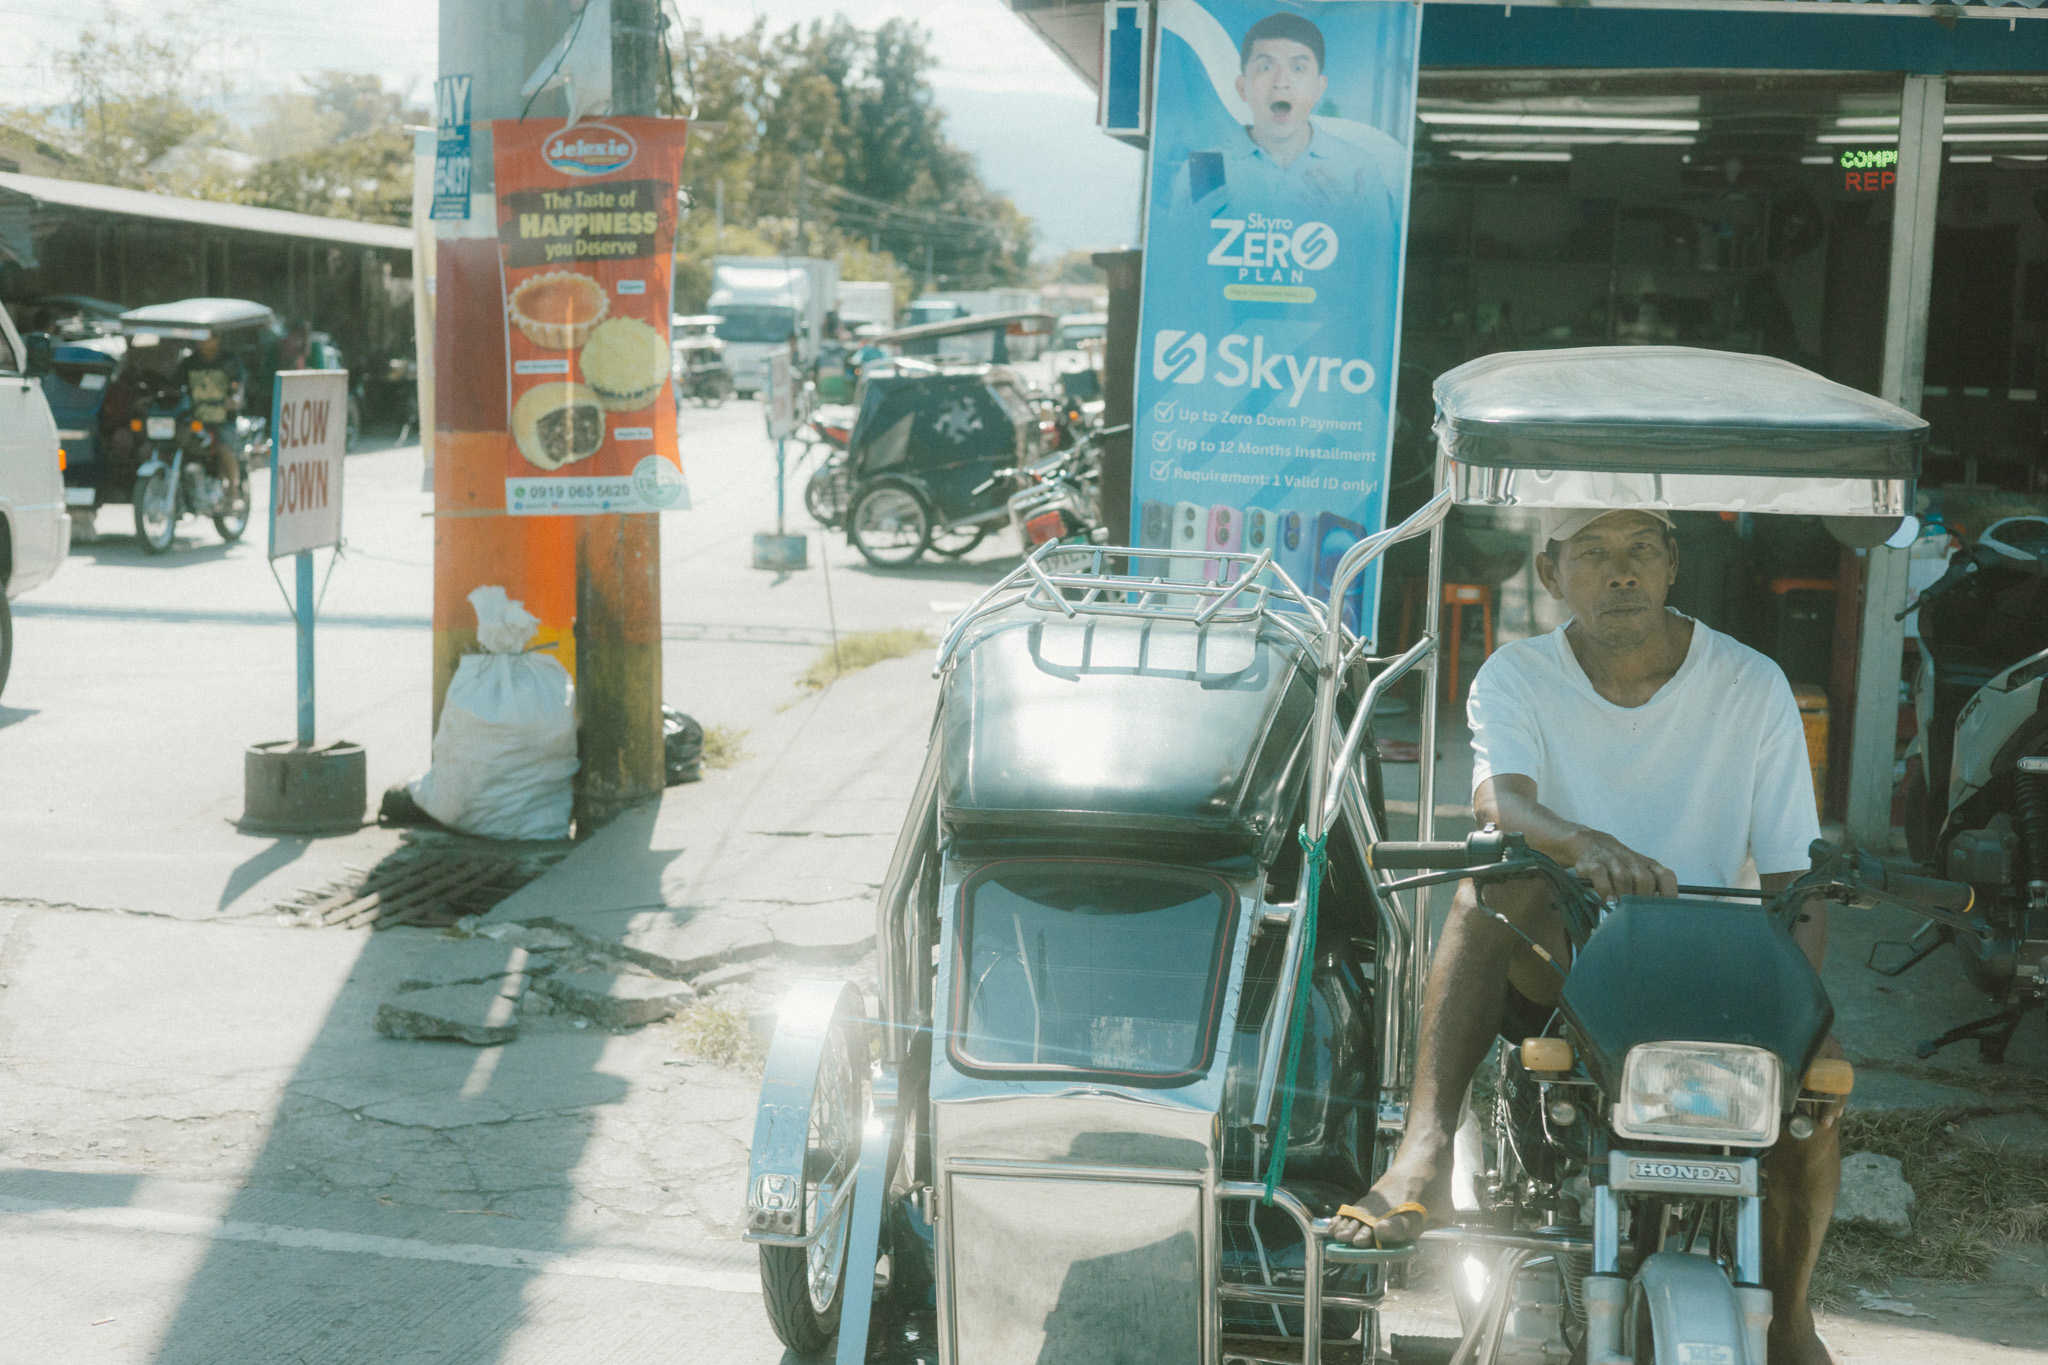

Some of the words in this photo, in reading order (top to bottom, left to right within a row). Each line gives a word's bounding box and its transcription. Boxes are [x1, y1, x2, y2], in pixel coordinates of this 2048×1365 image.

[1845, 171, 1896, 191] REP
[541, 192, 573, 211] The
[574, 190, 616, 209] Taste
[618, 189, 638, 208] of
[519, 210, 658, 239] HAPPINESS
[1247, 212, 1294, 233] Skyro
[545, 242, 574, 261] you
[576, 239, 638, 257] Deserve
[1239, 268, 1304, 283] PLAN
[1214, 333, 1376, 409] Skyro
[281, 399, 329, 448] SLOW
[1179, 408, 1199, 424] Up
[1203, 411, 1218, 423] to
[1221, 411, 1253, 425] Zero
[1256, 413, 1297, 428] Down
[1300, 416, 1363, 433] Payment
[1177, 438, 1197, 454] Up
[1200, 441, 1216, 453] to
[1219, 441, 1235, 454] 12
[1238, 442, 1292, 457] Months
[1295, 446, 1377, 463] Installment
[277, 460, 328, 515] DOWN
[530, 485, 564, 498] 0919
[1174, 466, 1271, 486] Requirement:
[1272, 474, 1281, 487] 1
[1284, 475, 1320, 489] Valid
[1323, 477, 1339, 490] ID
[1342, 479, 1379, 496] only!
[1635, 1162, 1736, 1183] HONDA
